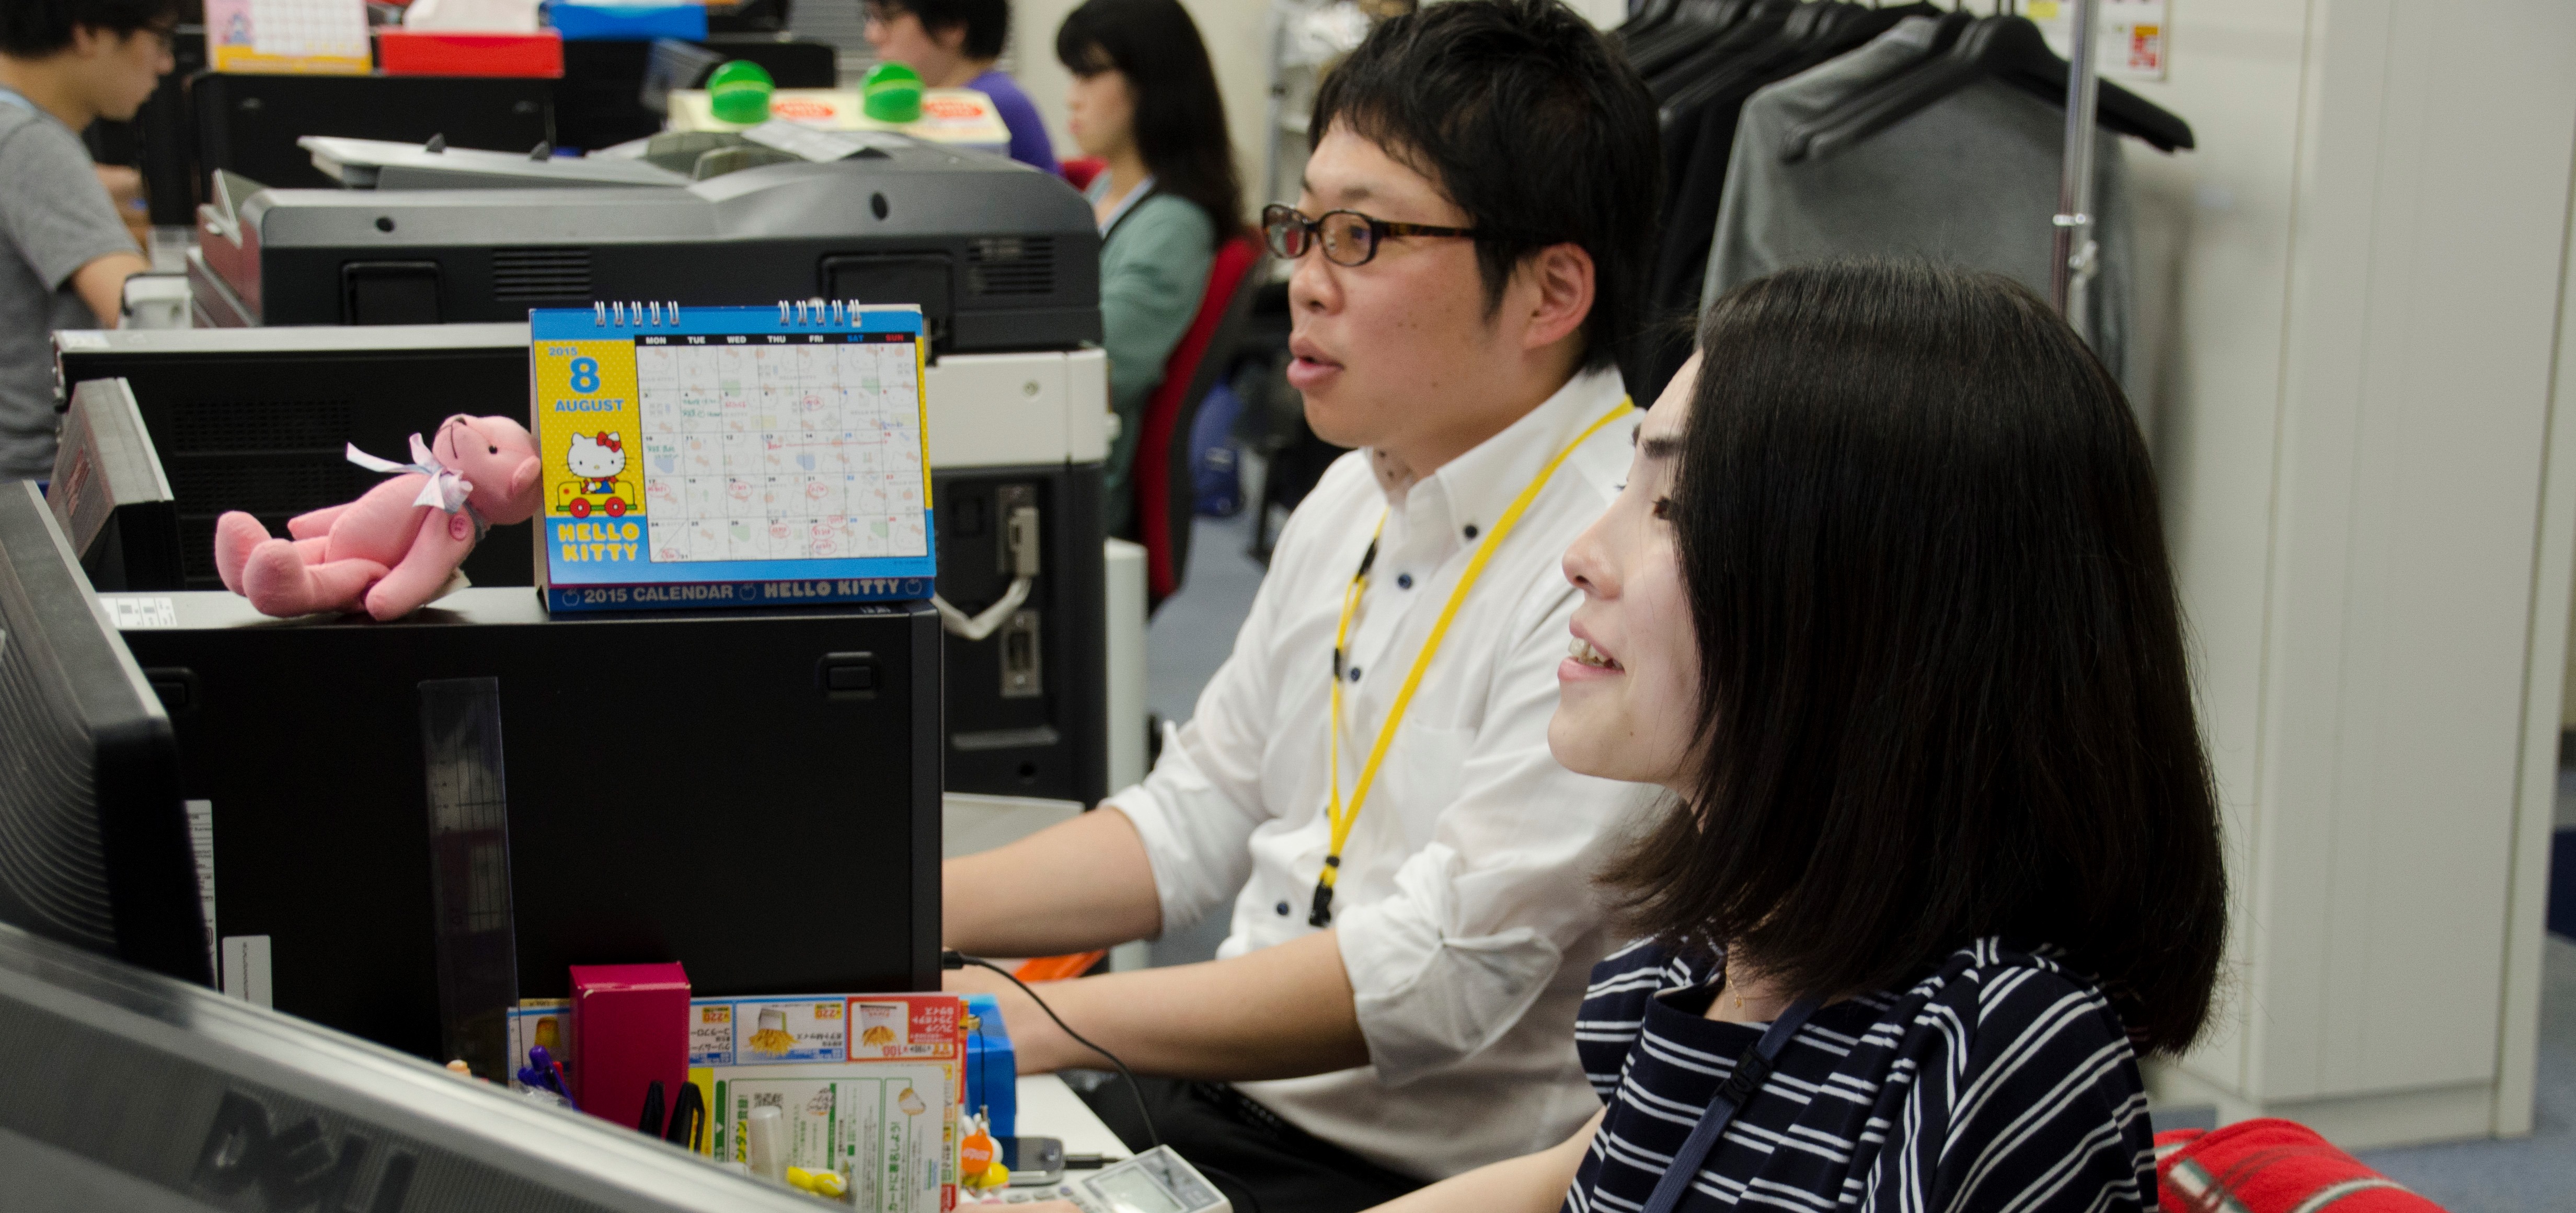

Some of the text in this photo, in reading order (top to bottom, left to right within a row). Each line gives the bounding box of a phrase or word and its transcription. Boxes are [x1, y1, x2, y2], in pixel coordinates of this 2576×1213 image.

[645, 333, 904, 345] MON TUE WED THU FRI SAT SUN
[548, 346, 578, 356] 2015
[569, 356, 601, 394] 8
[555, 399, 625, 412] AUGUST
[557, 523, 640, 541] HELLO
[561, 543, 639, 562] KITTY
[584, 579, 900, 603] 2015 CALENDAR HELLO KITTY
